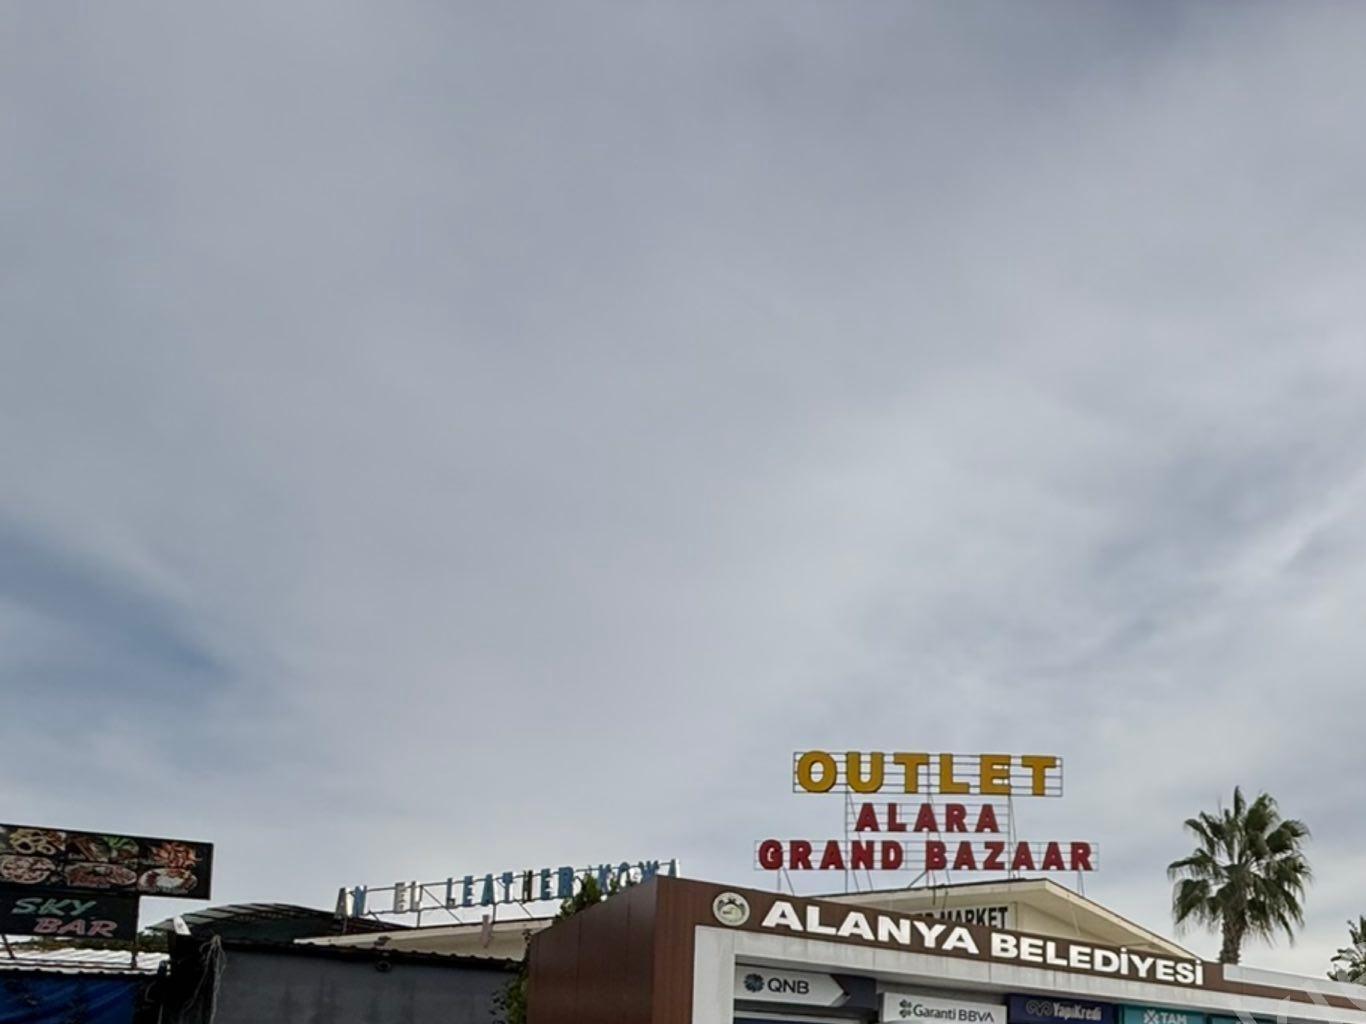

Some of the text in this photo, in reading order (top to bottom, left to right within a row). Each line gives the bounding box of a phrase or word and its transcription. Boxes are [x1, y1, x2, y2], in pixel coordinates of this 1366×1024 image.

[796, 750, 1056, 796] OUTLET
[854, 803, 1001, 834] ALARA
[758, 838, 1094, 872] GRAND BAZAAR
[446, 864, 577, 907] LEATHER
[11, 897, 97, 917] SKY
[33, 916, 119, 938] BAR
[761, 900, 1205, 987] ALANYA BELEDİYESİ
[767, 977, 810, 996] QNB
[912, 1004, 995, 1024] Garanti BBVA
